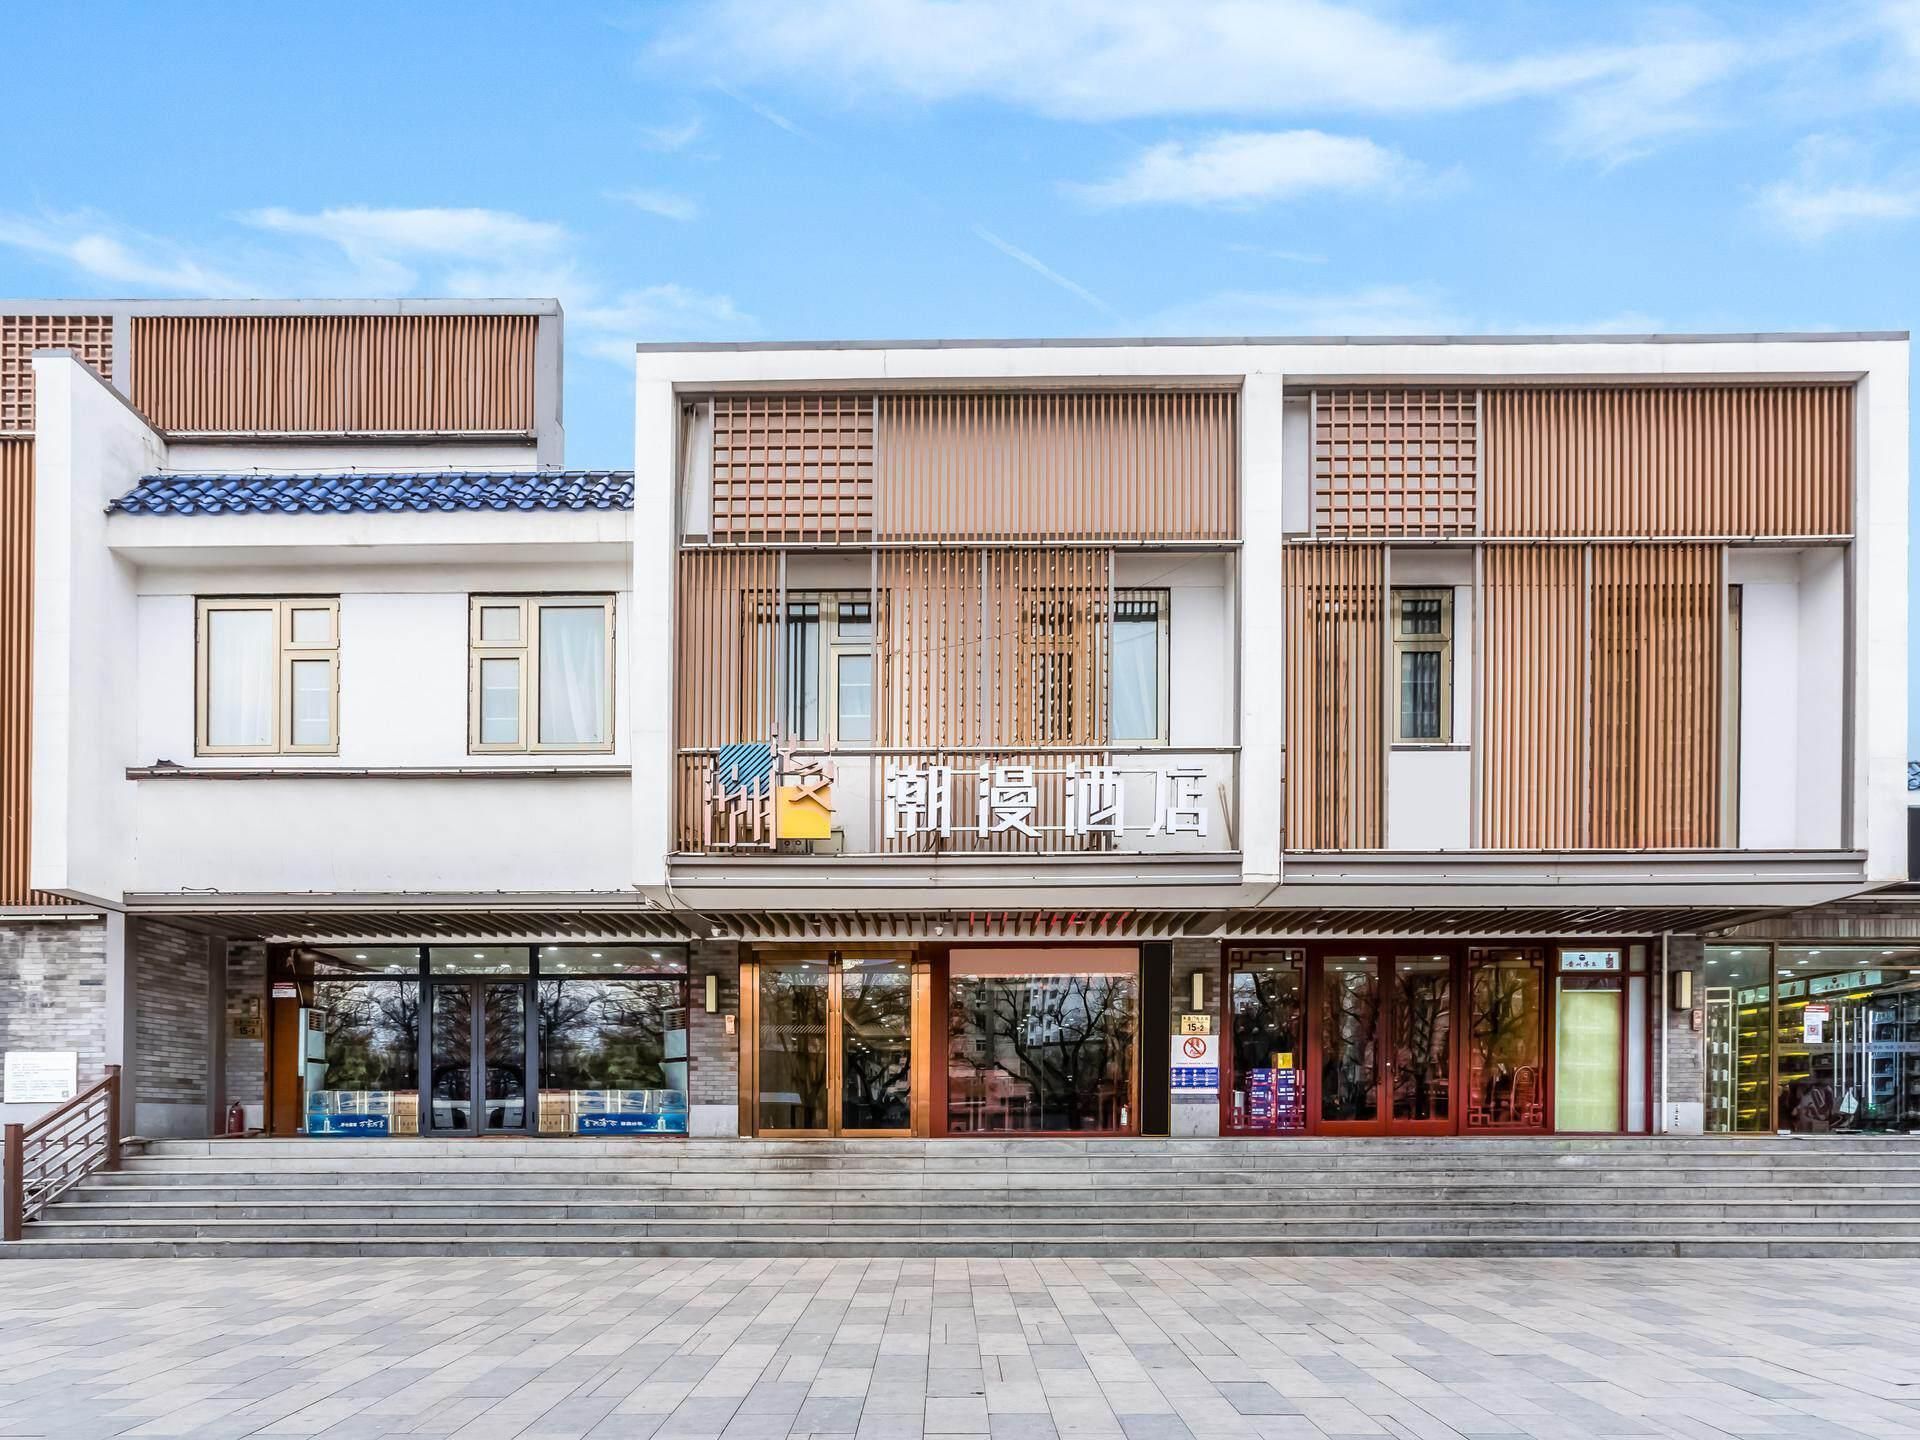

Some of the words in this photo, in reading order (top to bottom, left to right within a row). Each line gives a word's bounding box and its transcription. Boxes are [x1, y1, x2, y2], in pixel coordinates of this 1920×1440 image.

[885, 762, 1208, 838] 潮漫酒店
[1187, 1022, 1205, 1032] 15-2
